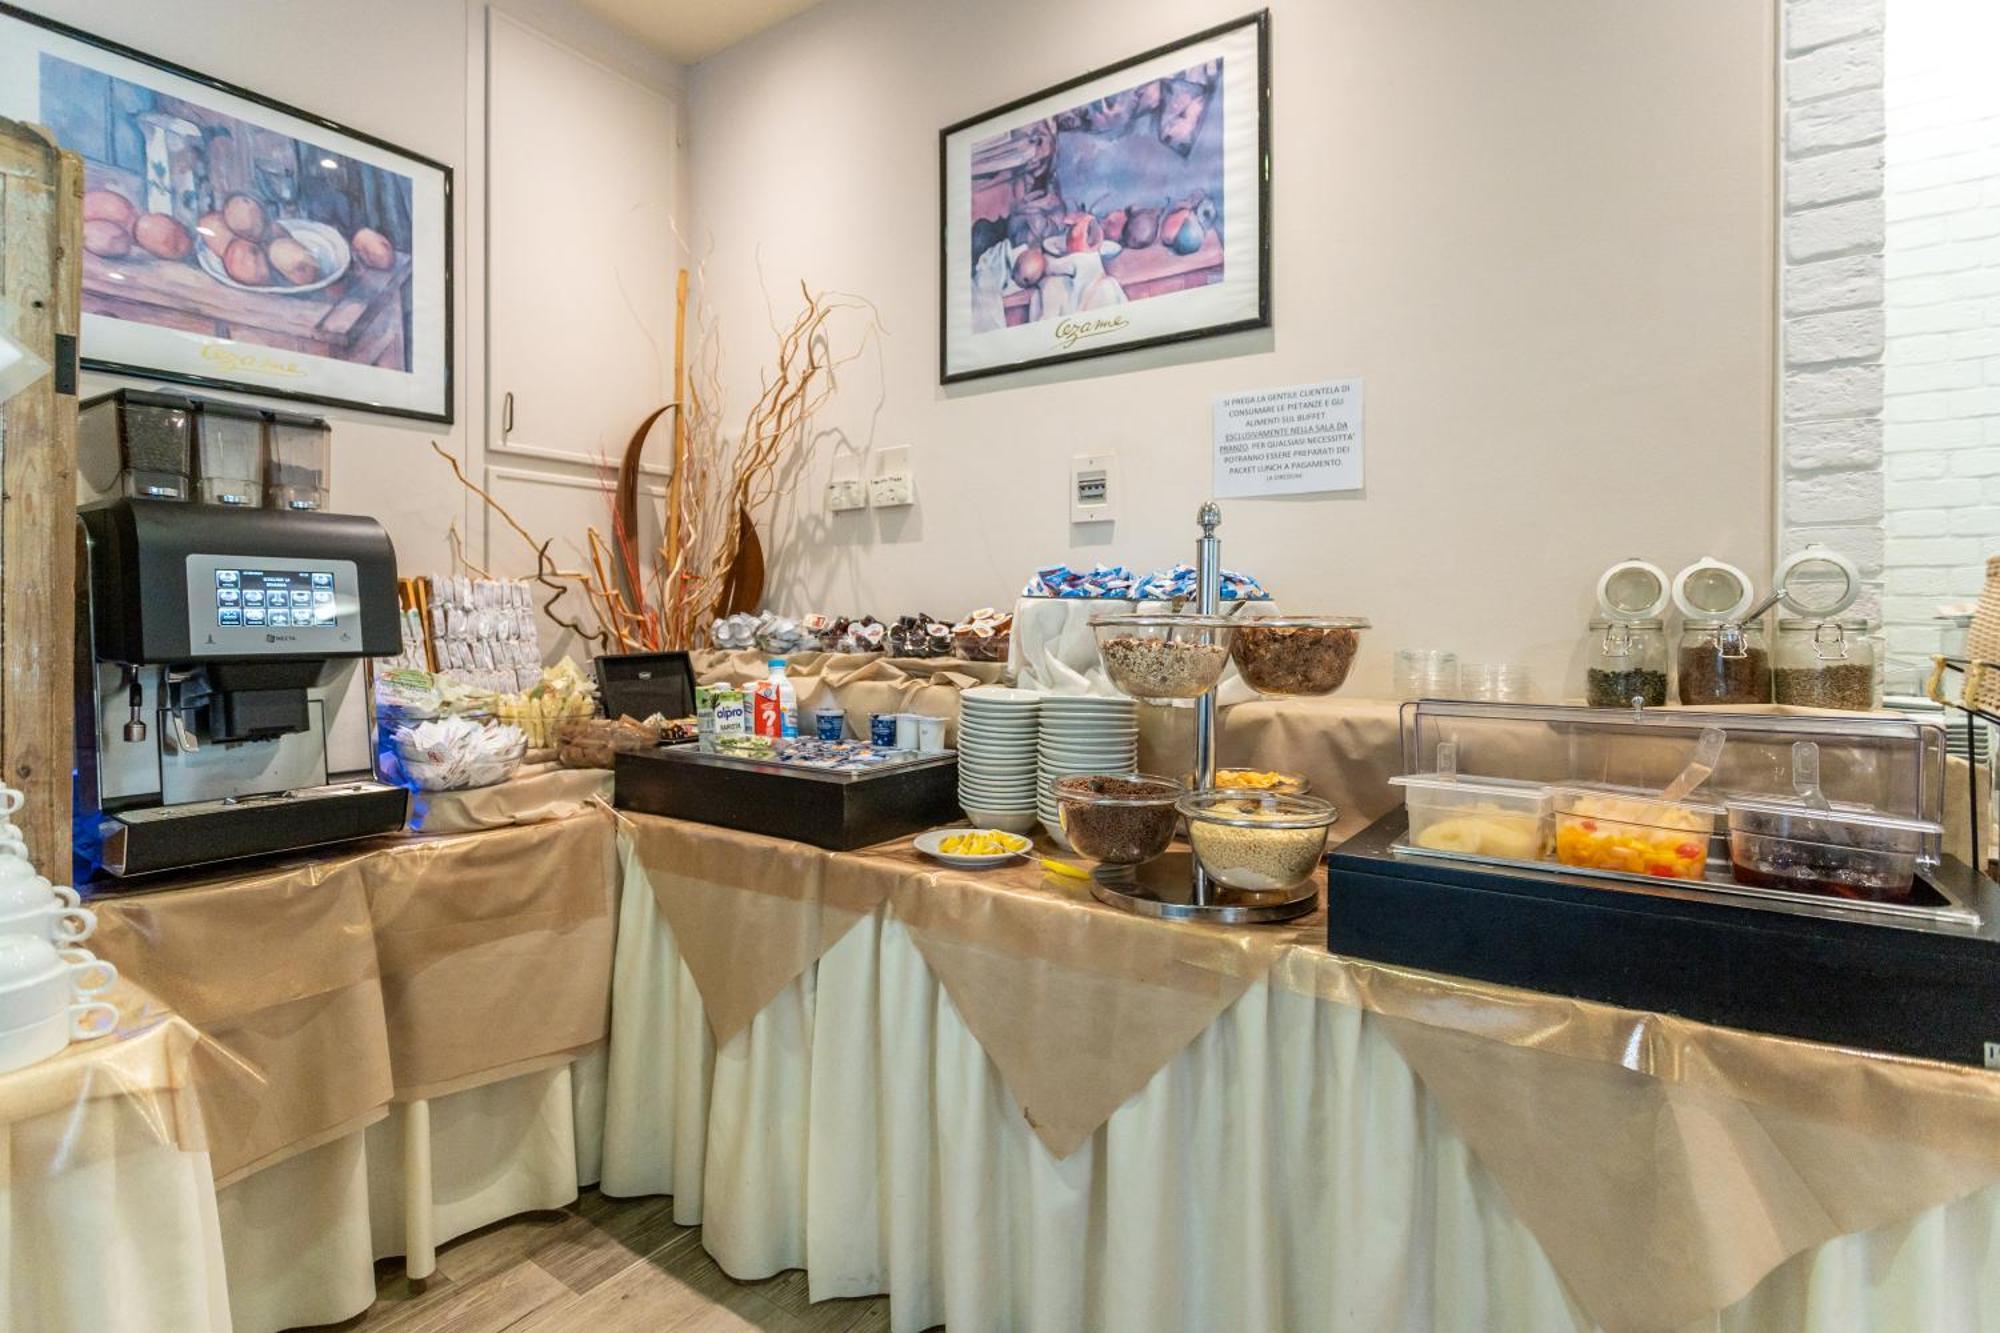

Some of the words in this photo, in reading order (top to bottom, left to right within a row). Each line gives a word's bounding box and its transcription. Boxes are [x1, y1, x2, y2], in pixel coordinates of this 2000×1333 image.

[1223, 399, 1230, 407] SI
[1231, 396, 1256, 406] PREGA
[1257, 394, 1266, 402] LA
[1267, 392, 1298, 401] GENTILE
[1299, 385, 1340, 398] CLIENTELA
[1340, 384, 1350, 393] DI
[1228, 405, 1275, 417] CONSUMARE
[1276, 404, 1284, 412] LE
[1287, 399, 1322, 411] PIETANZE
[1331, 397, 1344, 406] GLI
[1245, 417, 1280, 427] ALIMENTI
[1282, 415, 1295, 423] SUL
[1297, 411, 1325, 422] BUFFET
[1225, 427, 1288, 442] ESCLUSIVAMENTE
[1290, 425, 1314, 435] NELLA
[1315, 423, 1334, 433] SALA
[1336, 421, 1348, 431] DA
[1251, 441, 1265, 449] PER
[1267, 438, 1305, 449] QUALSIASI
[1224, 453, 1265, 464] POTRANNO
[1266, 450, 1291, 460] ESSERE
[1293, 446, 1334, 458] PREPARATI
[1336, 446, 1350, 454] DEI
[1229, 465, 1256, 475] PACKET
[1257, 463, 1282, 473] LUNCH
[716, 707, 743, 720] alpro
